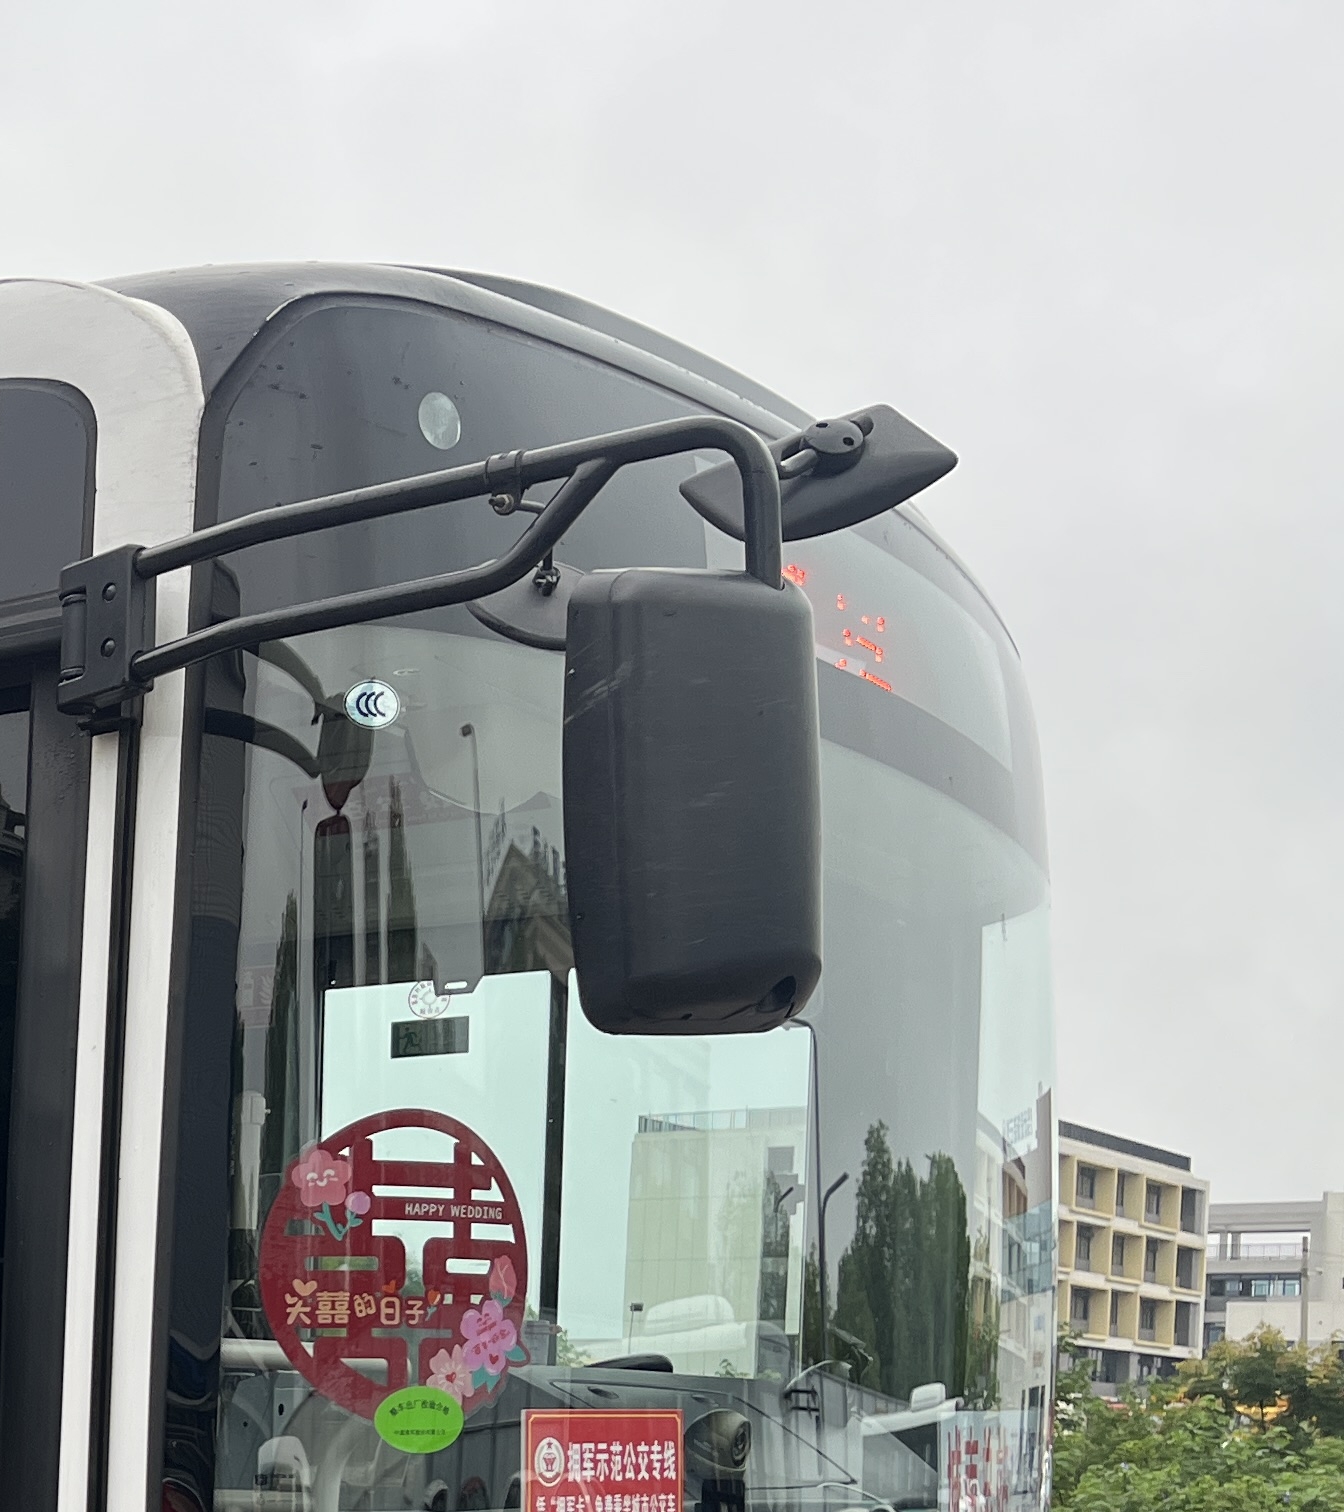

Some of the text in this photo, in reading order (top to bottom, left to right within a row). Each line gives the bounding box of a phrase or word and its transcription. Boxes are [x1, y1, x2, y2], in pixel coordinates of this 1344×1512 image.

[405, 1202, 503, 1220] HAPPY WEDDING
[567, 1440, 676, 1483] 拥军示范公交专线
